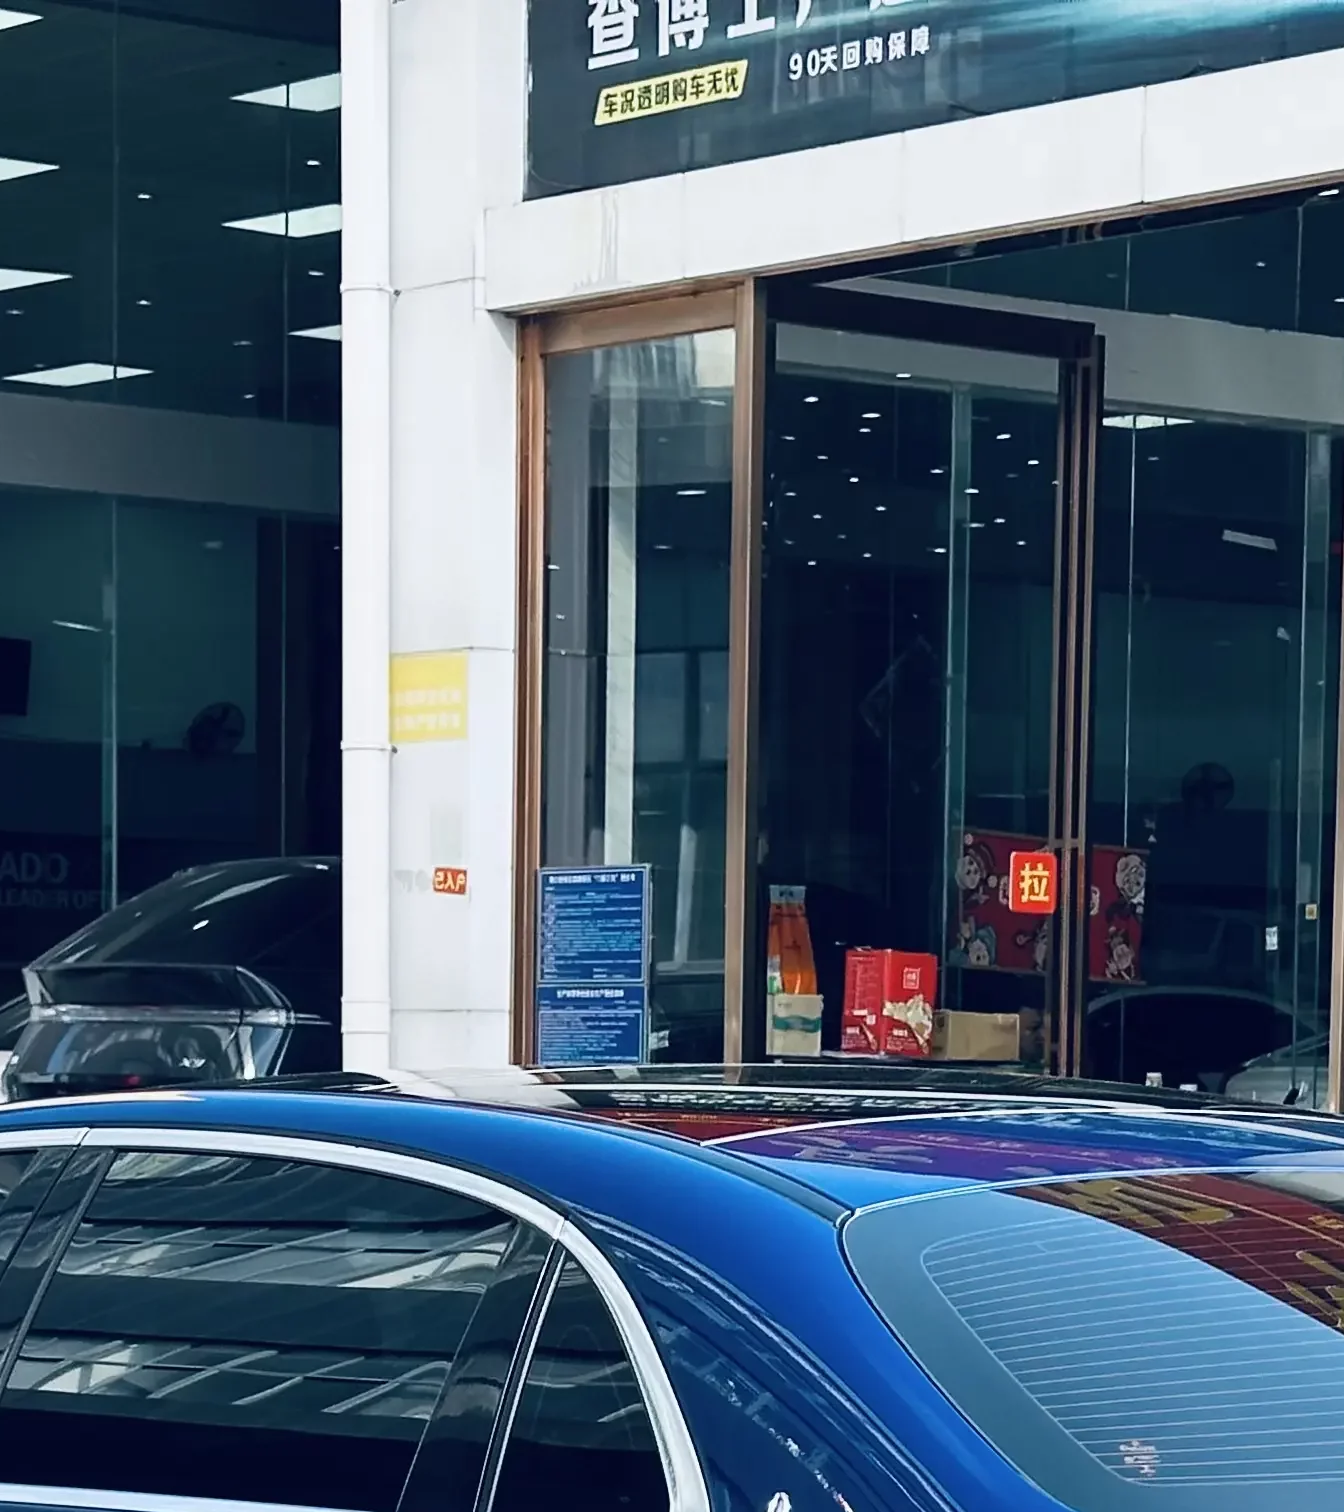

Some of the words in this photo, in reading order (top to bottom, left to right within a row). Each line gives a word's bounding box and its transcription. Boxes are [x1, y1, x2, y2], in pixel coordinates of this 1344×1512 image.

[789, 26, 931, 81] 90天回购保障
[603, 67, 739, 118] 车况透明购车无忧
[1020, 862, 1051, 904] 拉
